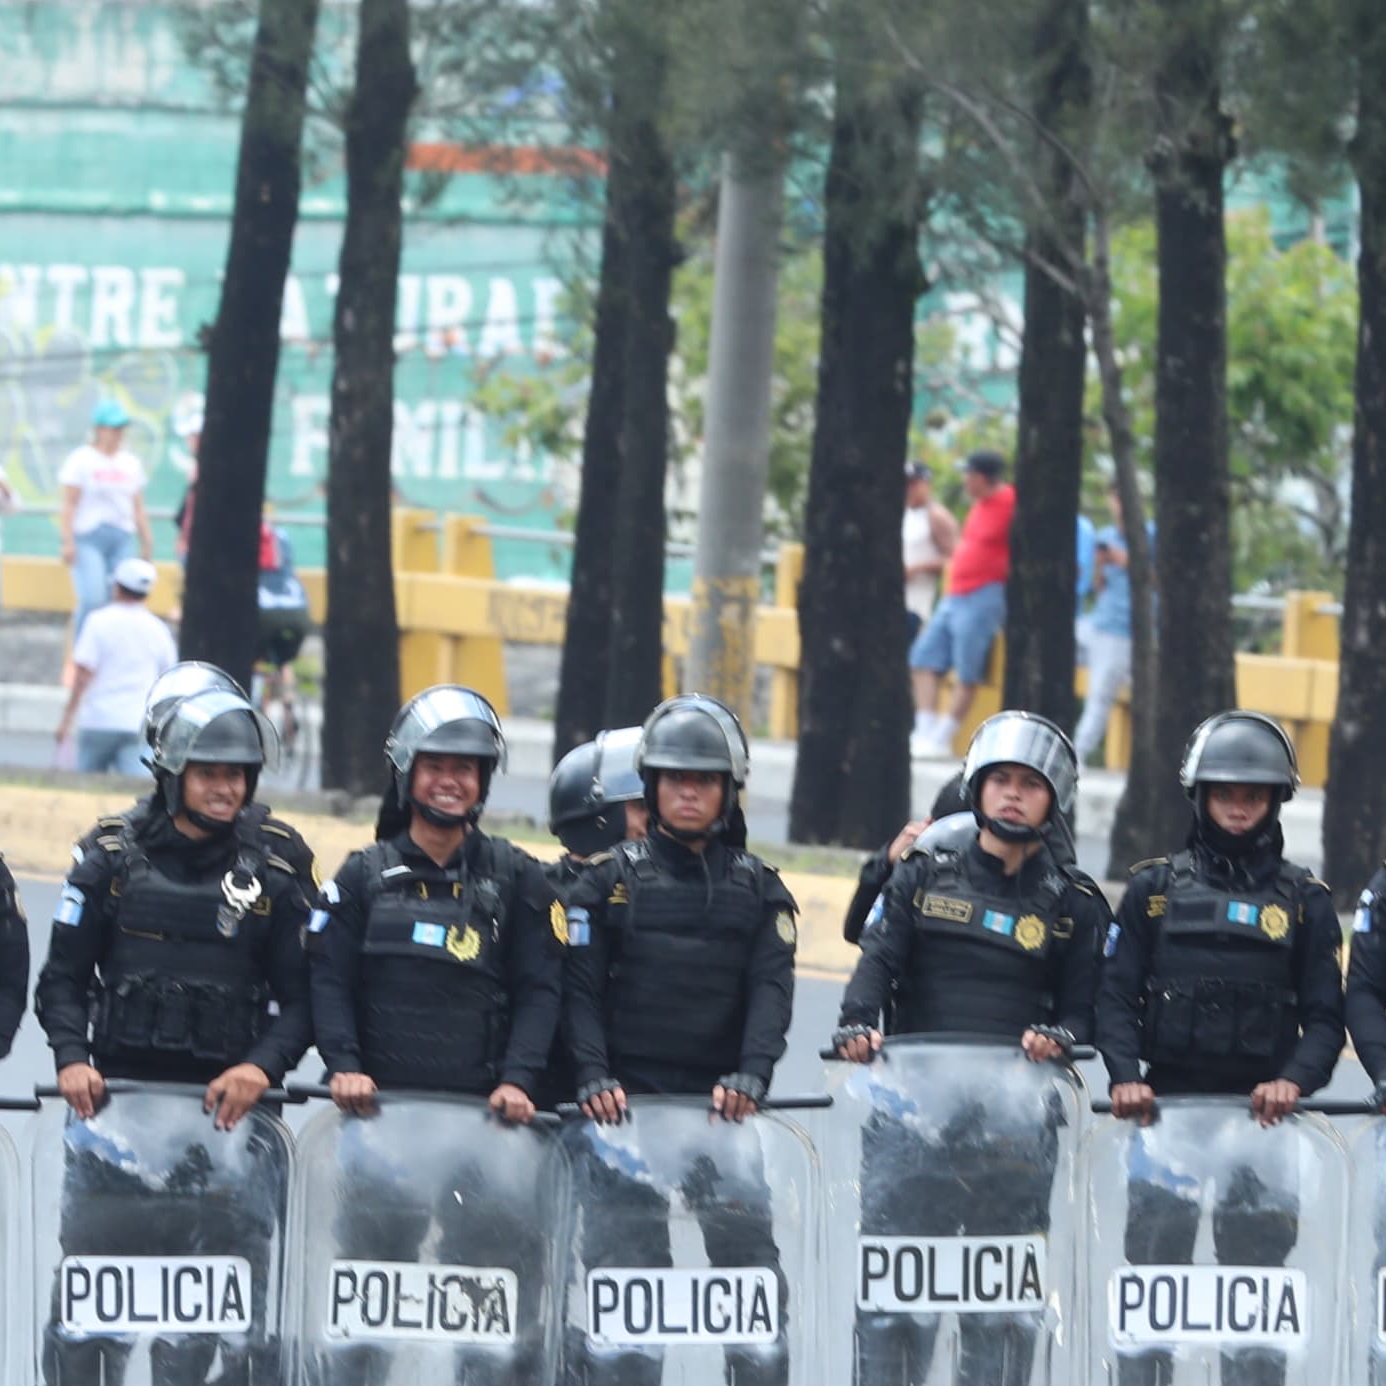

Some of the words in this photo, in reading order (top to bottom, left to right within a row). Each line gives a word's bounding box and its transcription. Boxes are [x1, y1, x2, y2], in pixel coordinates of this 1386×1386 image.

[66, 1265, 245, 1323] POLICIA
[860, 1245, 1042, 1302] POLICIA
[592, 1276, 774, 1334] POLICIA
[1118, 1274, 1300, 1334] POLICIA
